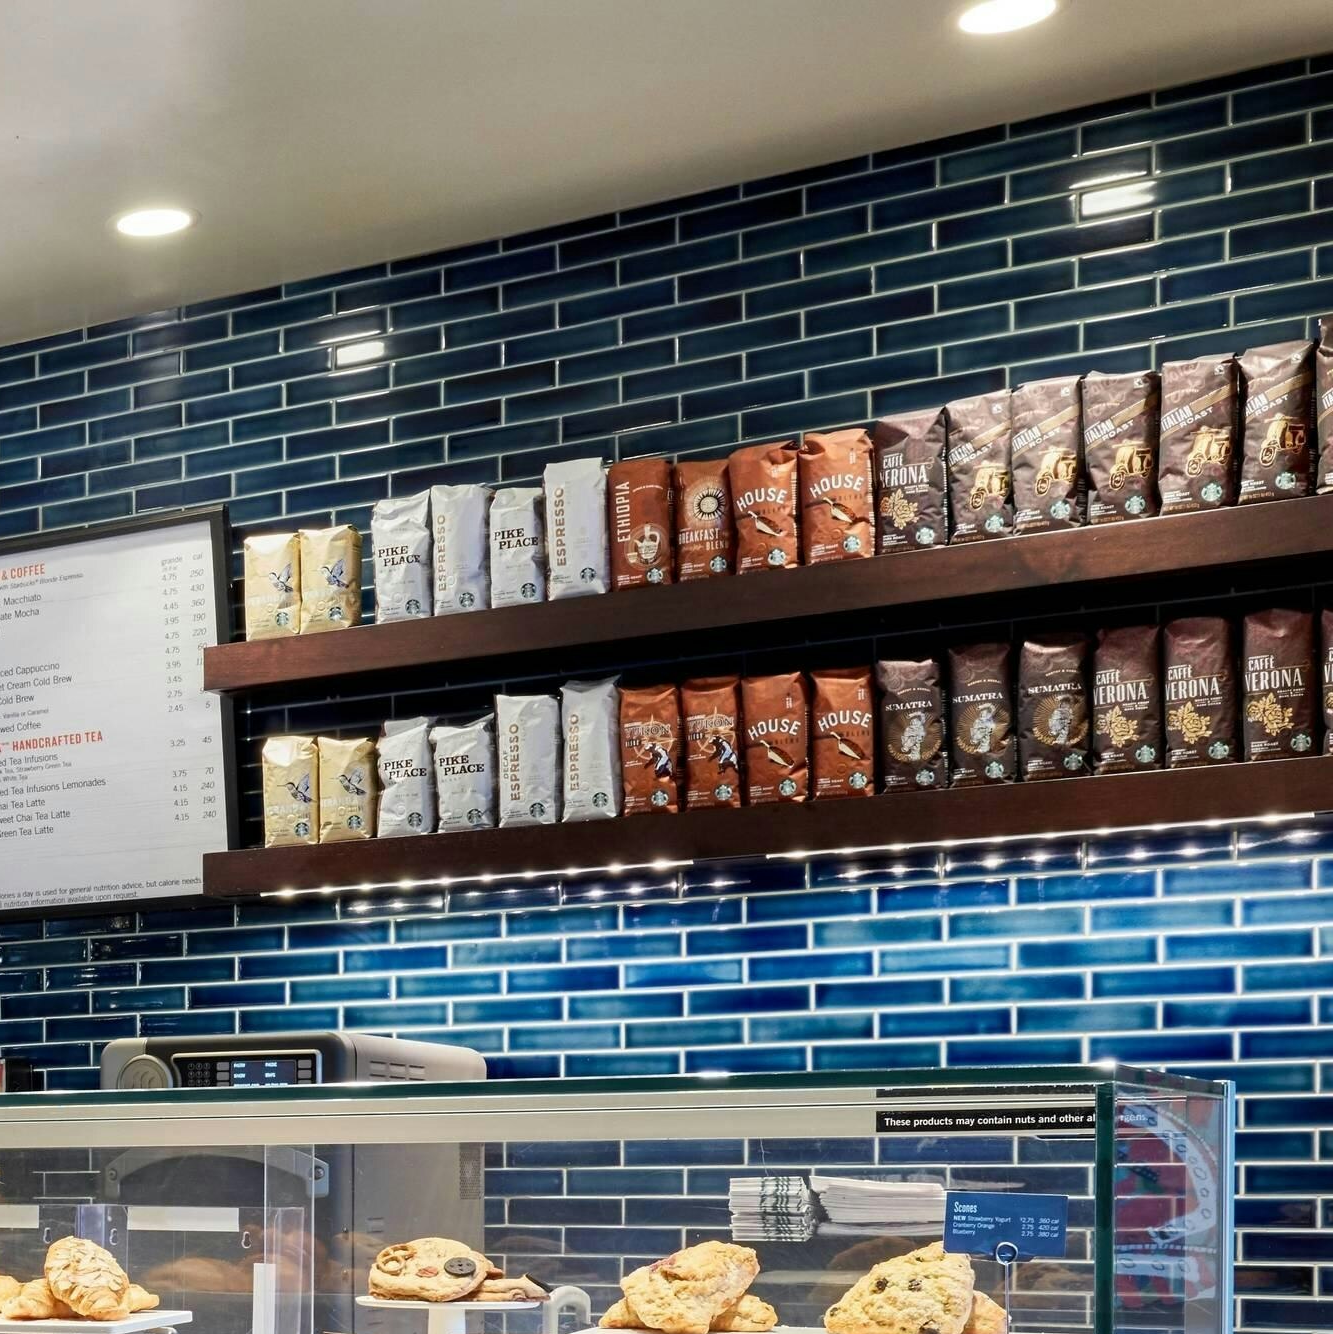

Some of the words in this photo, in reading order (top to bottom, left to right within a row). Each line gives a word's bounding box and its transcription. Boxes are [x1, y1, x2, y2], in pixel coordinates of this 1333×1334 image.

[1160, 405, 1193, 433] ITALIAN
[1178, 406, 1214, 429] ROAST
[809, 473, 864, 499] HOUSE
[736, 487, 788, 513] HOUSE
[617, 481, 631, 543] ETHIOPIA
[493, 528, 525, 541] PIKE
[554, 487, 567, 567] ESPRESSO
[378, 545, 409, 558] PIKE
[498, 537, 539, 550] PLACE
[383, 554, 421, 567] PLACE
[437, 513, 447, 592] ESPRESSO
[1, 570, 8, 580] &
[10, 563, 46, 579] COFFEE
[3, 594, 42, 606] Macchiato
[14, 608, 40, 618] Mocha
[1248, 655, 1275, 671] CAFFÈ
[1027, 682, 1082, 695] SUMATRA
[1244, 669, 1303, 692] VERONA
[12, 733, 82, 751] HANDCRAFTED
[84, 730, 103, 742] TEA
[954, 1202, 977, 1213] Scones
